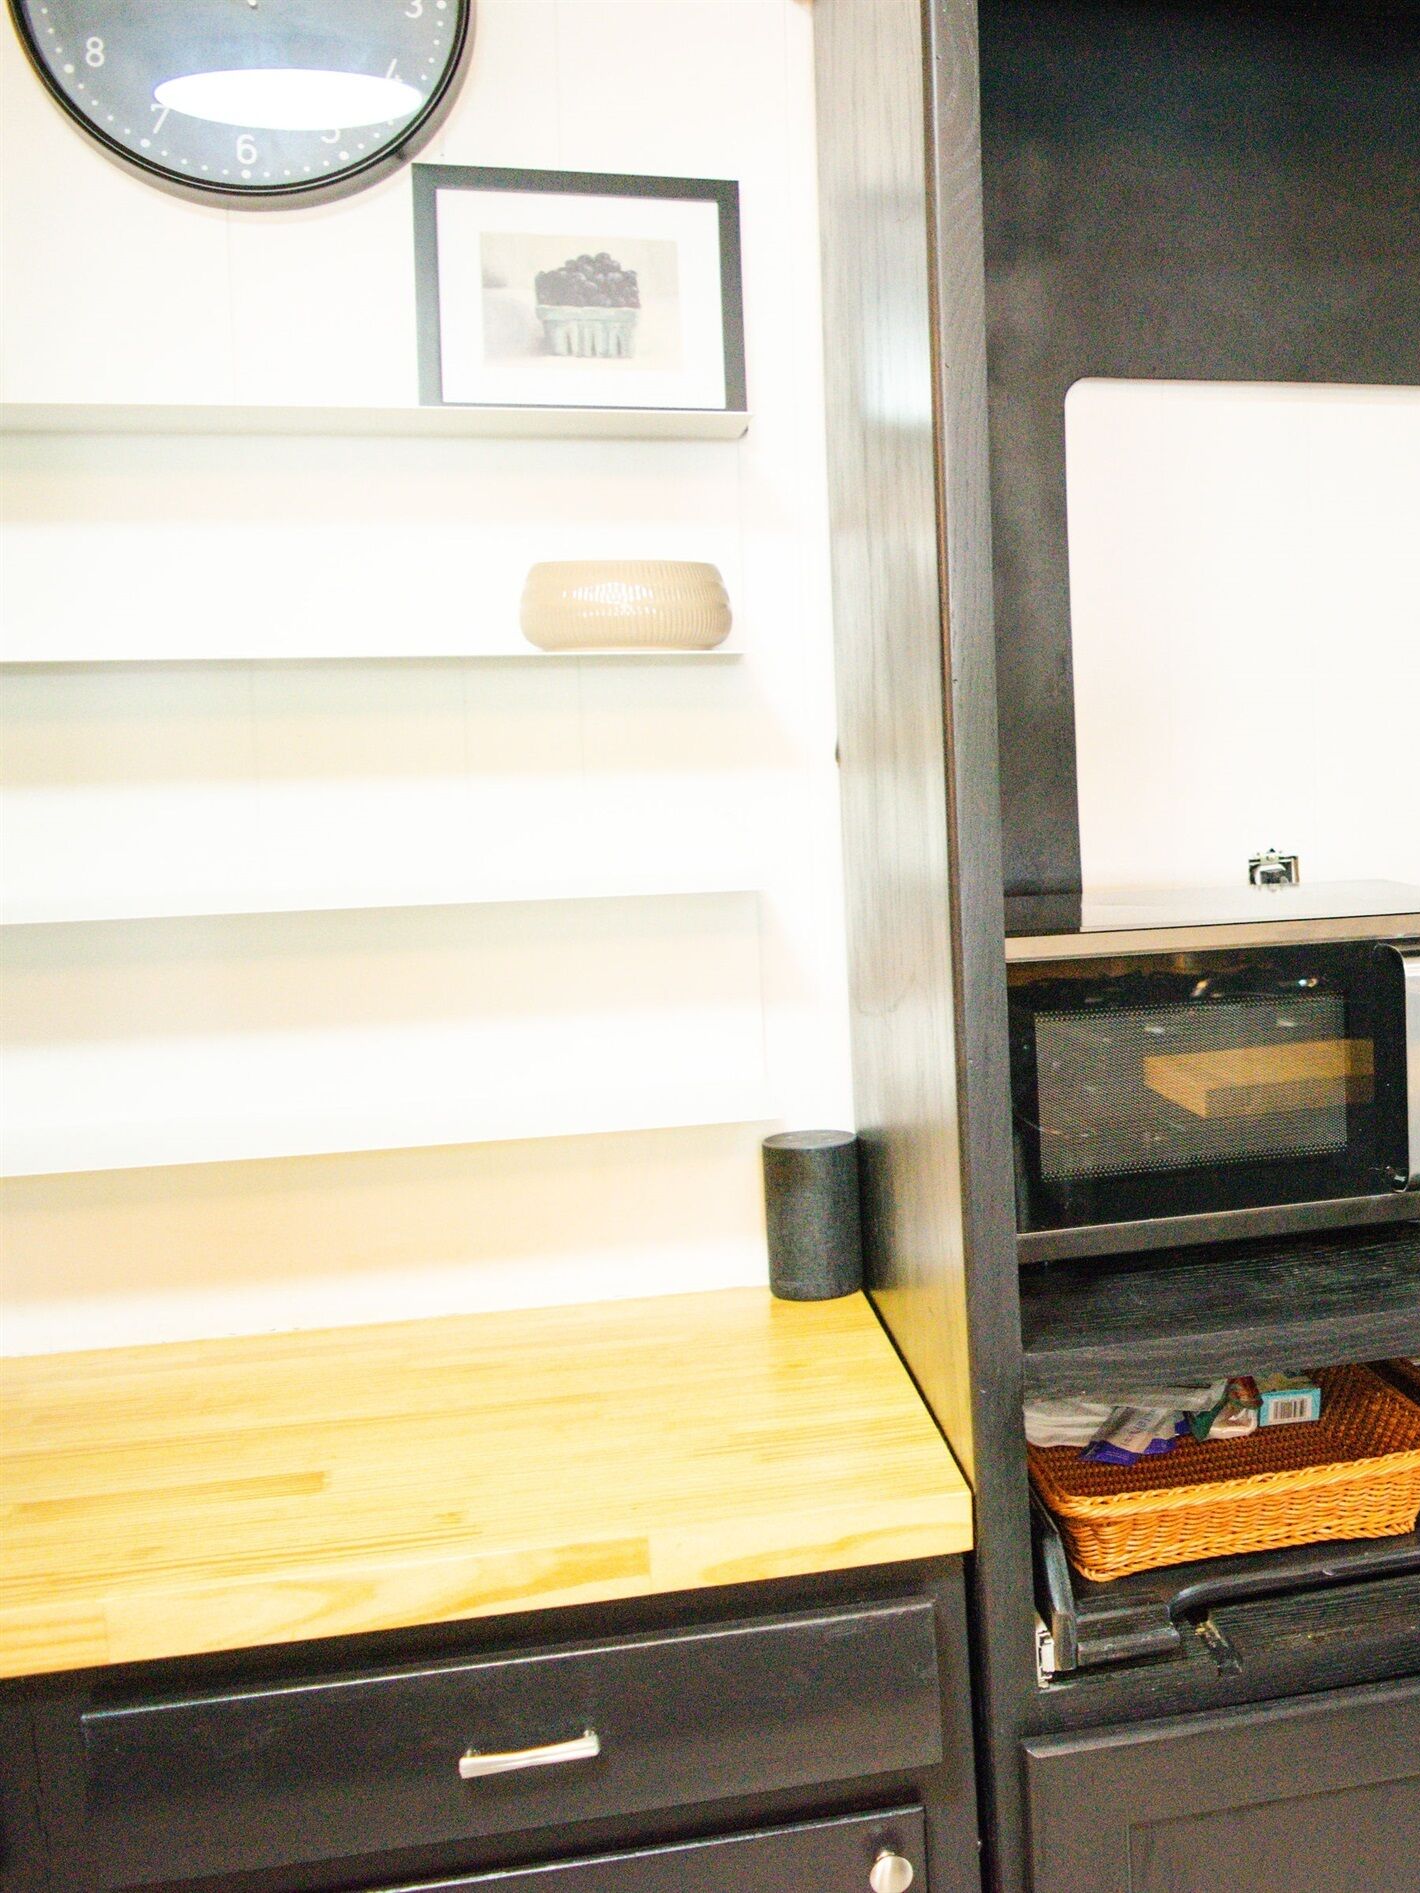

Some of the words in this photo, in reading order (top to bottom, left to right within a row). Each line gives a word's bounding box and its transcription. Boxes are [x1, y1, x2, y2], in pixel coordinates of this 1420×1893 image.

[405, 0, 423, 18] 3
[85, 37, 105, 67] 8
[151, 103, 170, 134] 7
[236, 134, 258, 164] 6
